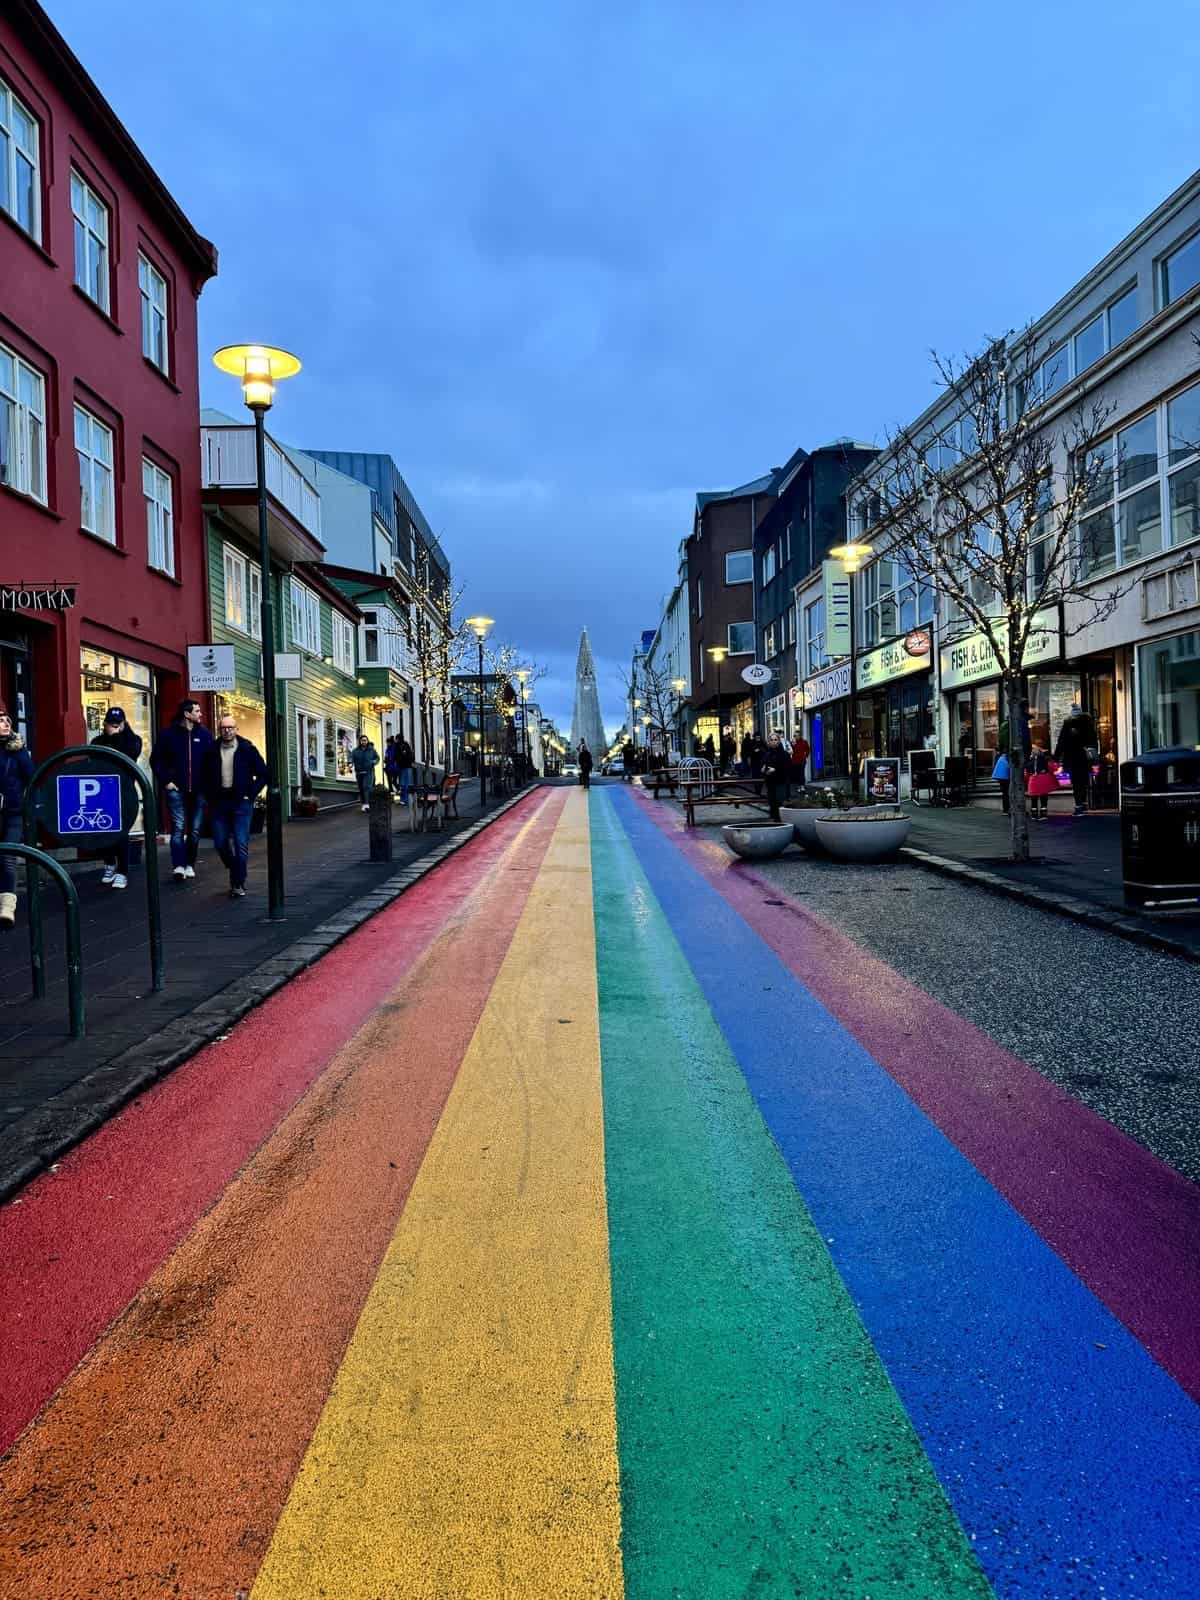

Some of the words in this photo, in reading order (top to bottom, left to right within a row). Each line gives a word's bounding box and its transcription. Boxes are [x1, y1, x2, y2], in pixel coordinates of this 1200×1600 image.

[2, 589, 75, 611] MOKKA
[951, 646, 969, 671] FISH
[971, 644, 978, 662] &
[963, 661, 993, 677] RESTAURANT
[79, 779, 100, 805] P
